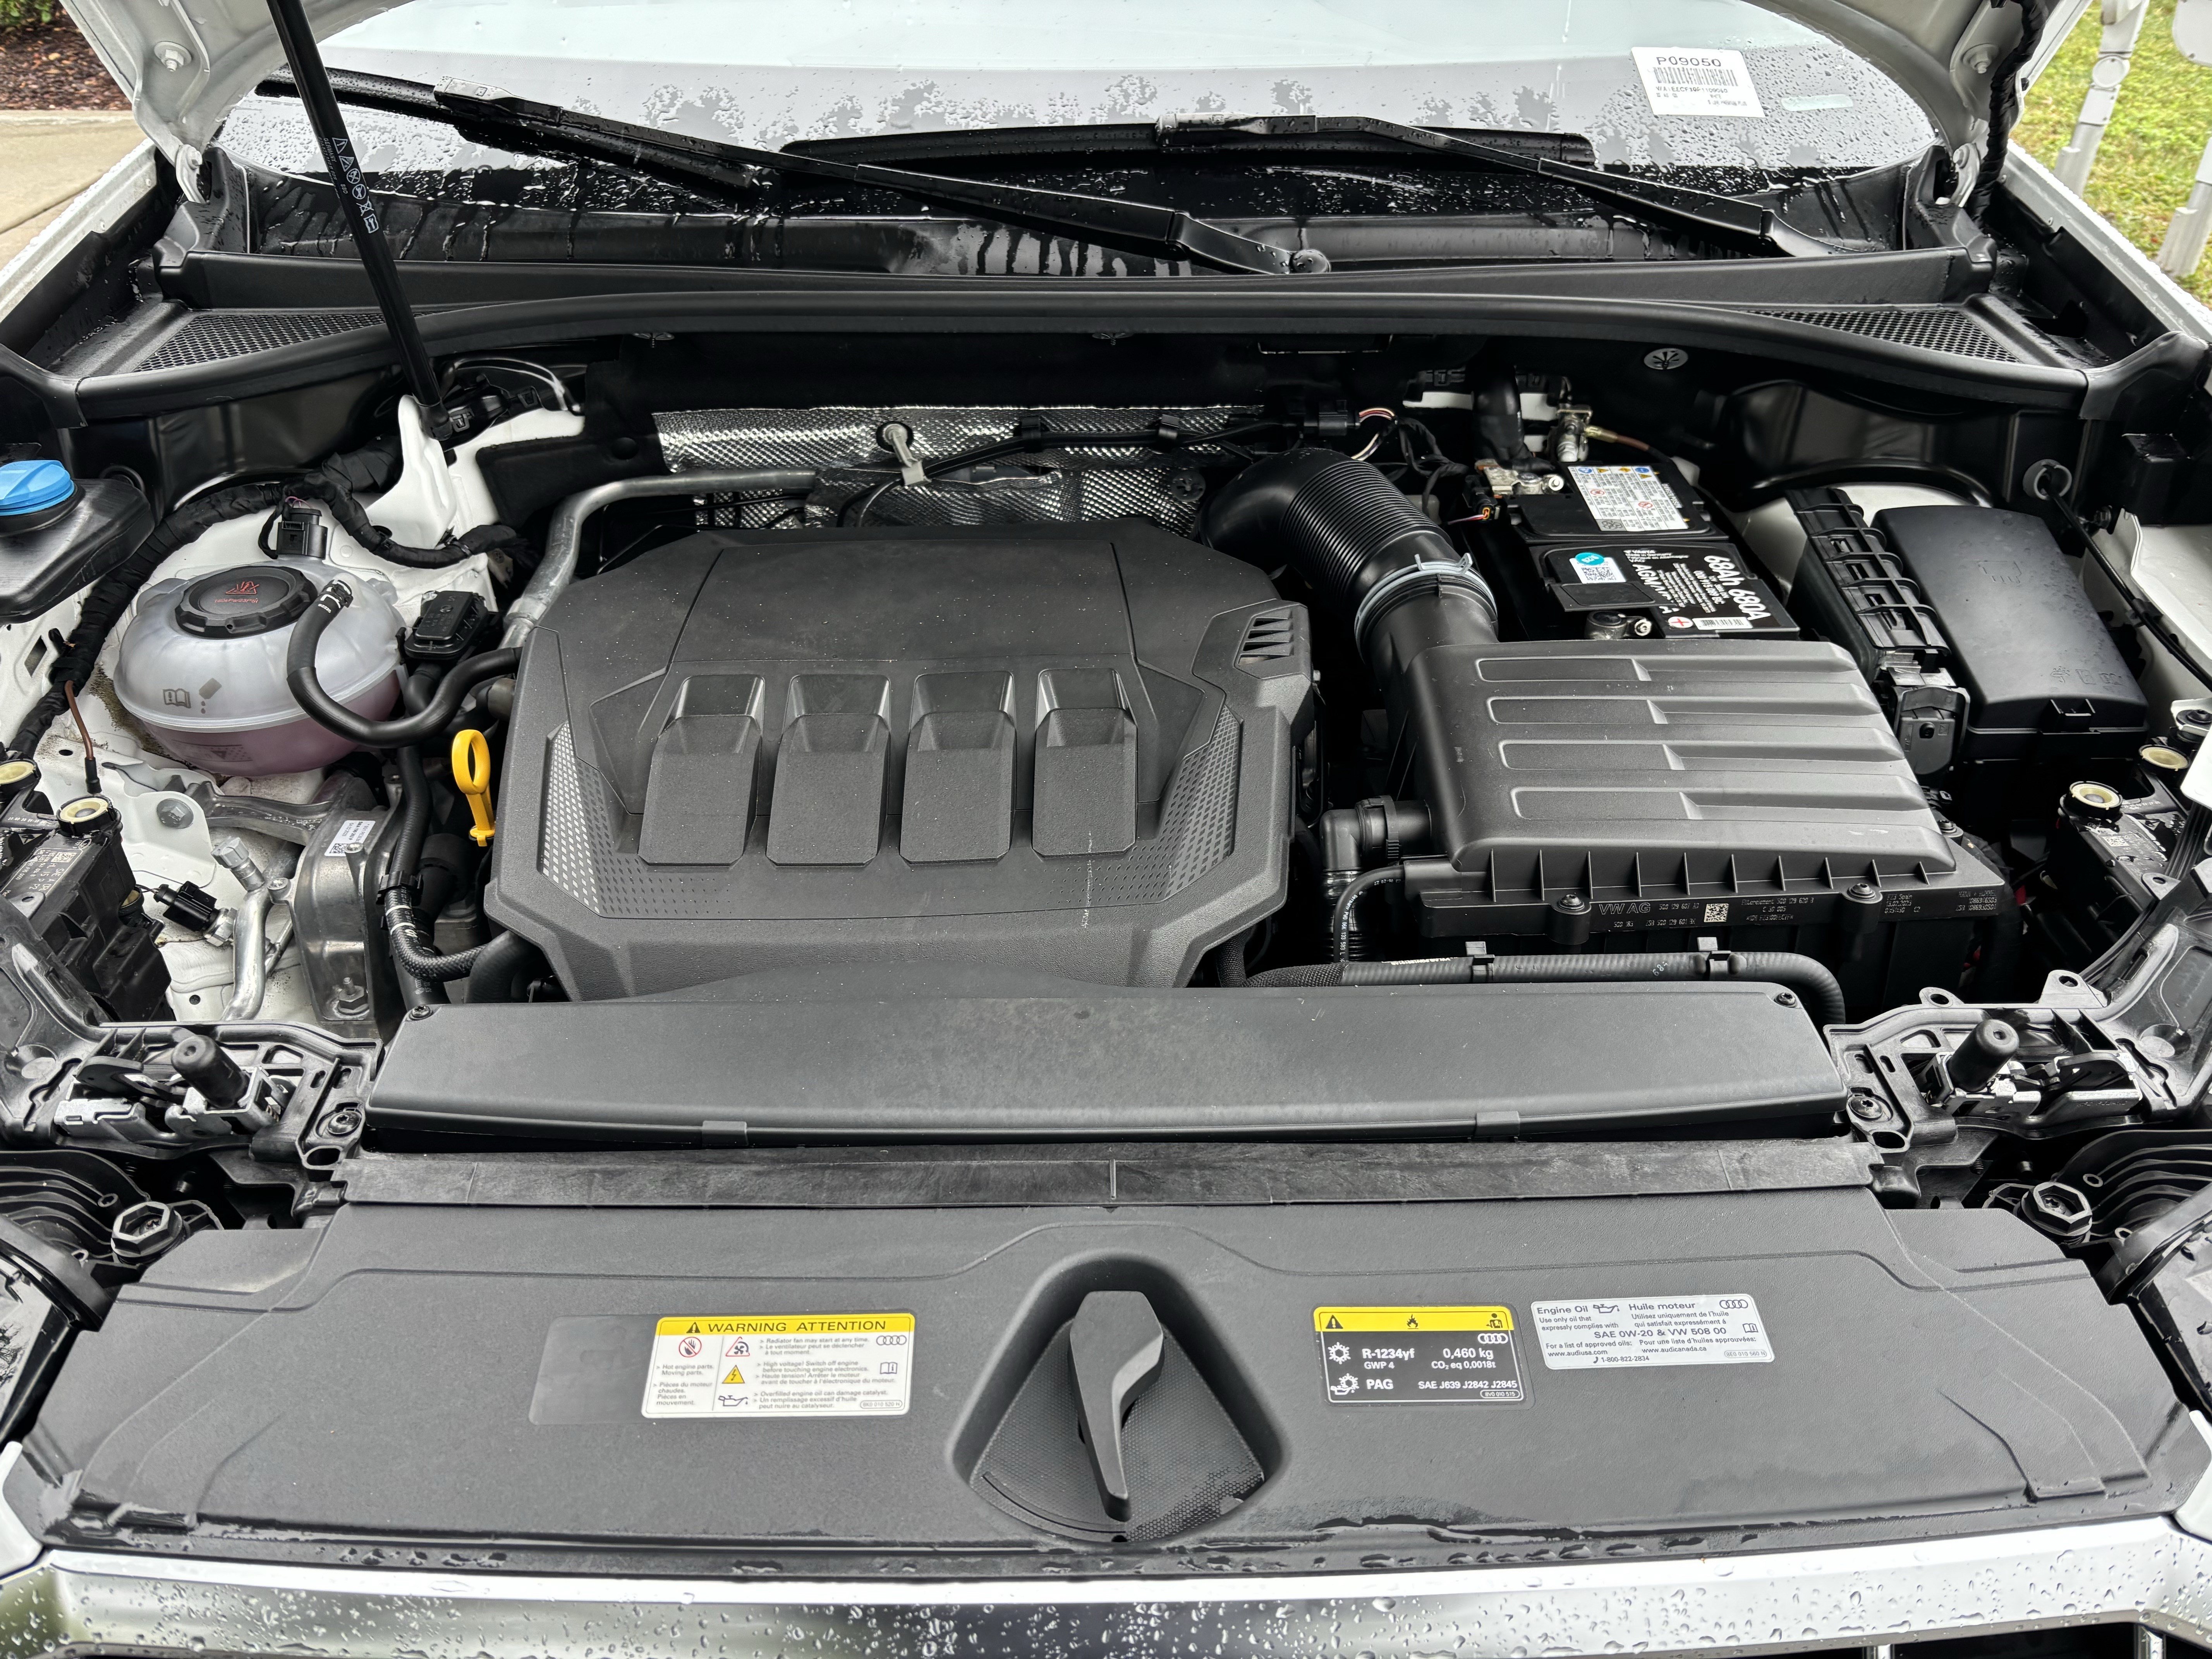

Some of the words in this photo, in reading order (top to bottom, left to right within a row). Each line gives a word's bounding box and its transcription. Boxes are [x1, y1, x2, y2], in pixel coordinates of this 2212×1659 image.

[1656, 57, 1721, 67] P09050
[1704, 556, 1745, 586] 68Ah
[1728, 589, 1771, 620] 680A
[1599, 903, 1625, 914] VW
[1626, 902, 1650, 913] AG
[708, 1322, 786, 1332] WARNING
[797, 1321, 885, 1331] ATTENTION
[1362, 1348, 1415, 1360] R-1234yf
[1443, 1348, 1476, 1359] 0,460
[1479, 1348, 1494, 1360] kg
[1366, 1379, 1393, 1389] PAG
